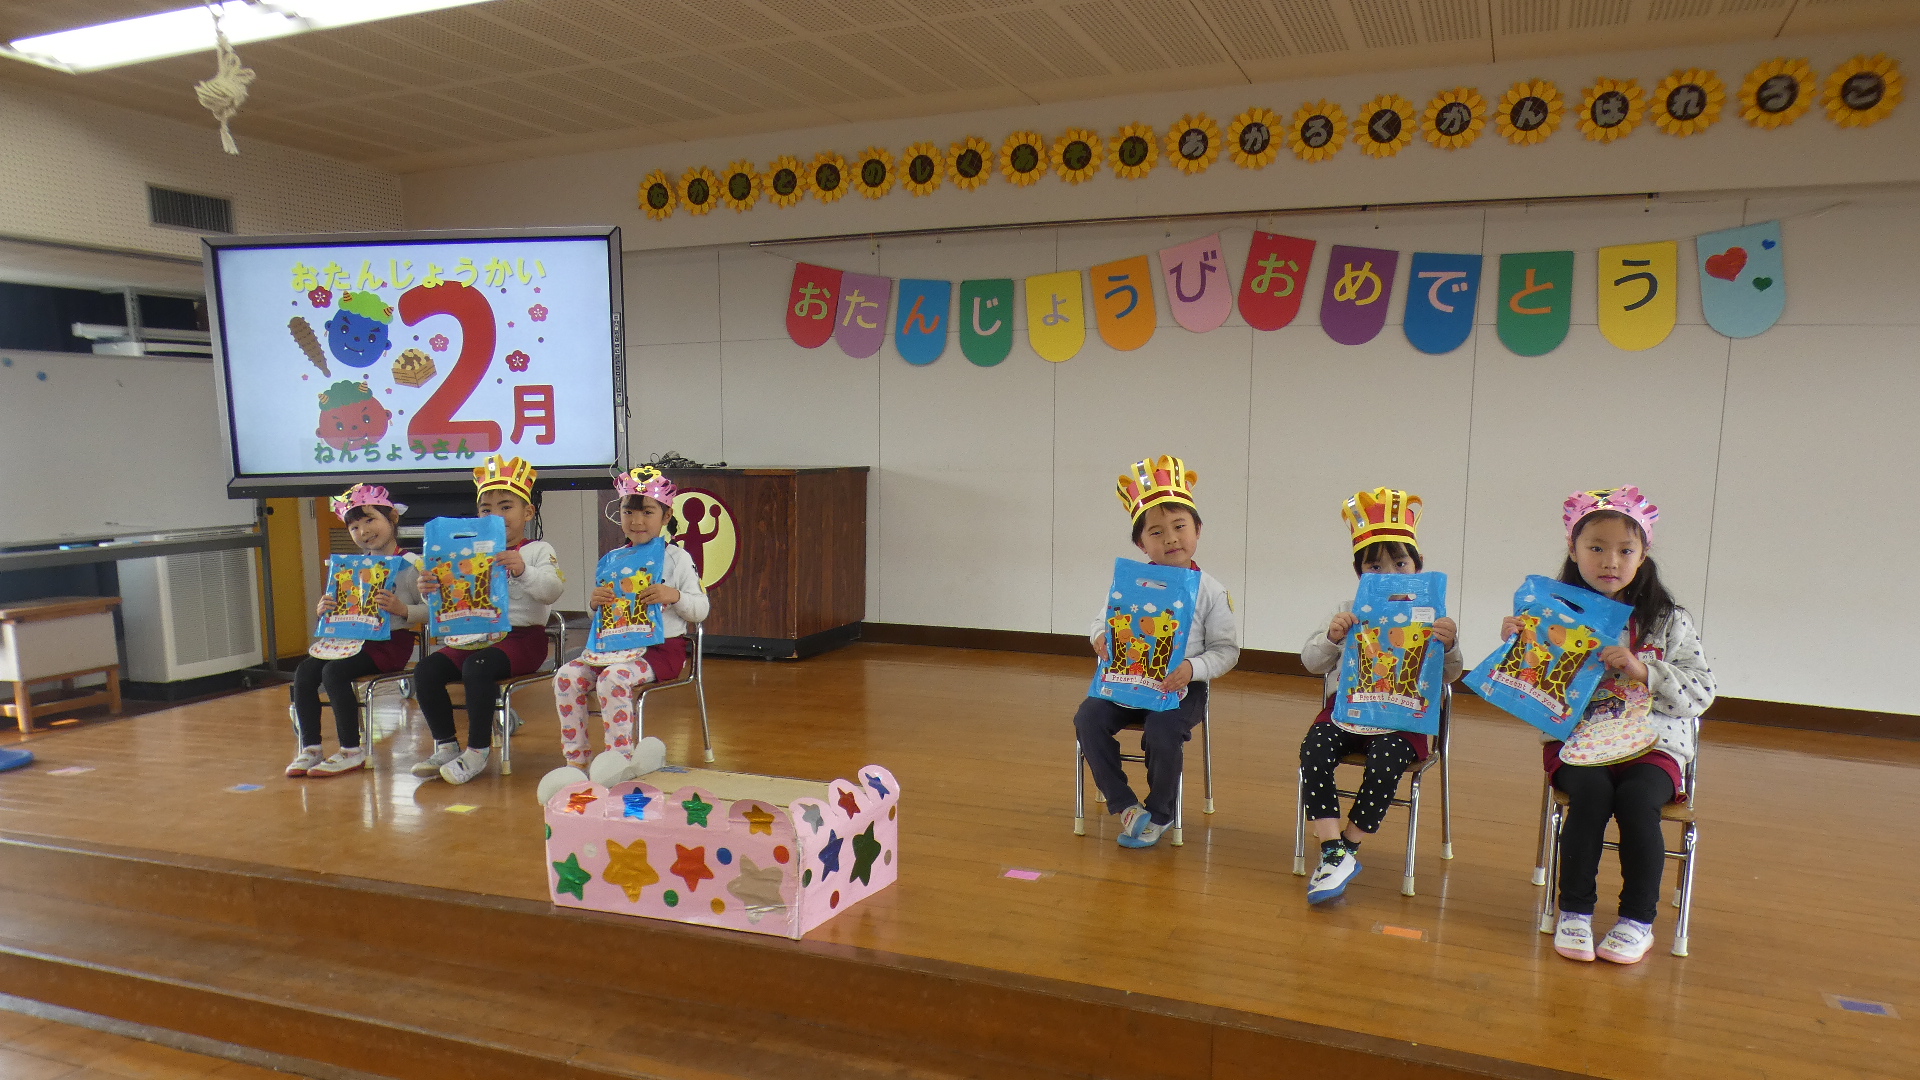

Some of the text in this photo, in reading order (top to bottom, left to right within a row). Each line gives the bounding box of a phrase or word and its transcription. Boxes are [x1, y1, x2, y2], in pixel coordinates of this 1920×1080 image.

[291, 256, 547, 292] おたんじょうかい
[794, 250, 1658, 336] おたんじょうびおめでとう
[313, 437, 476, 464] ねんちょうさん
[1112, 674, 1138, 683] Present
[1497, 673, 1527, 690] Present
